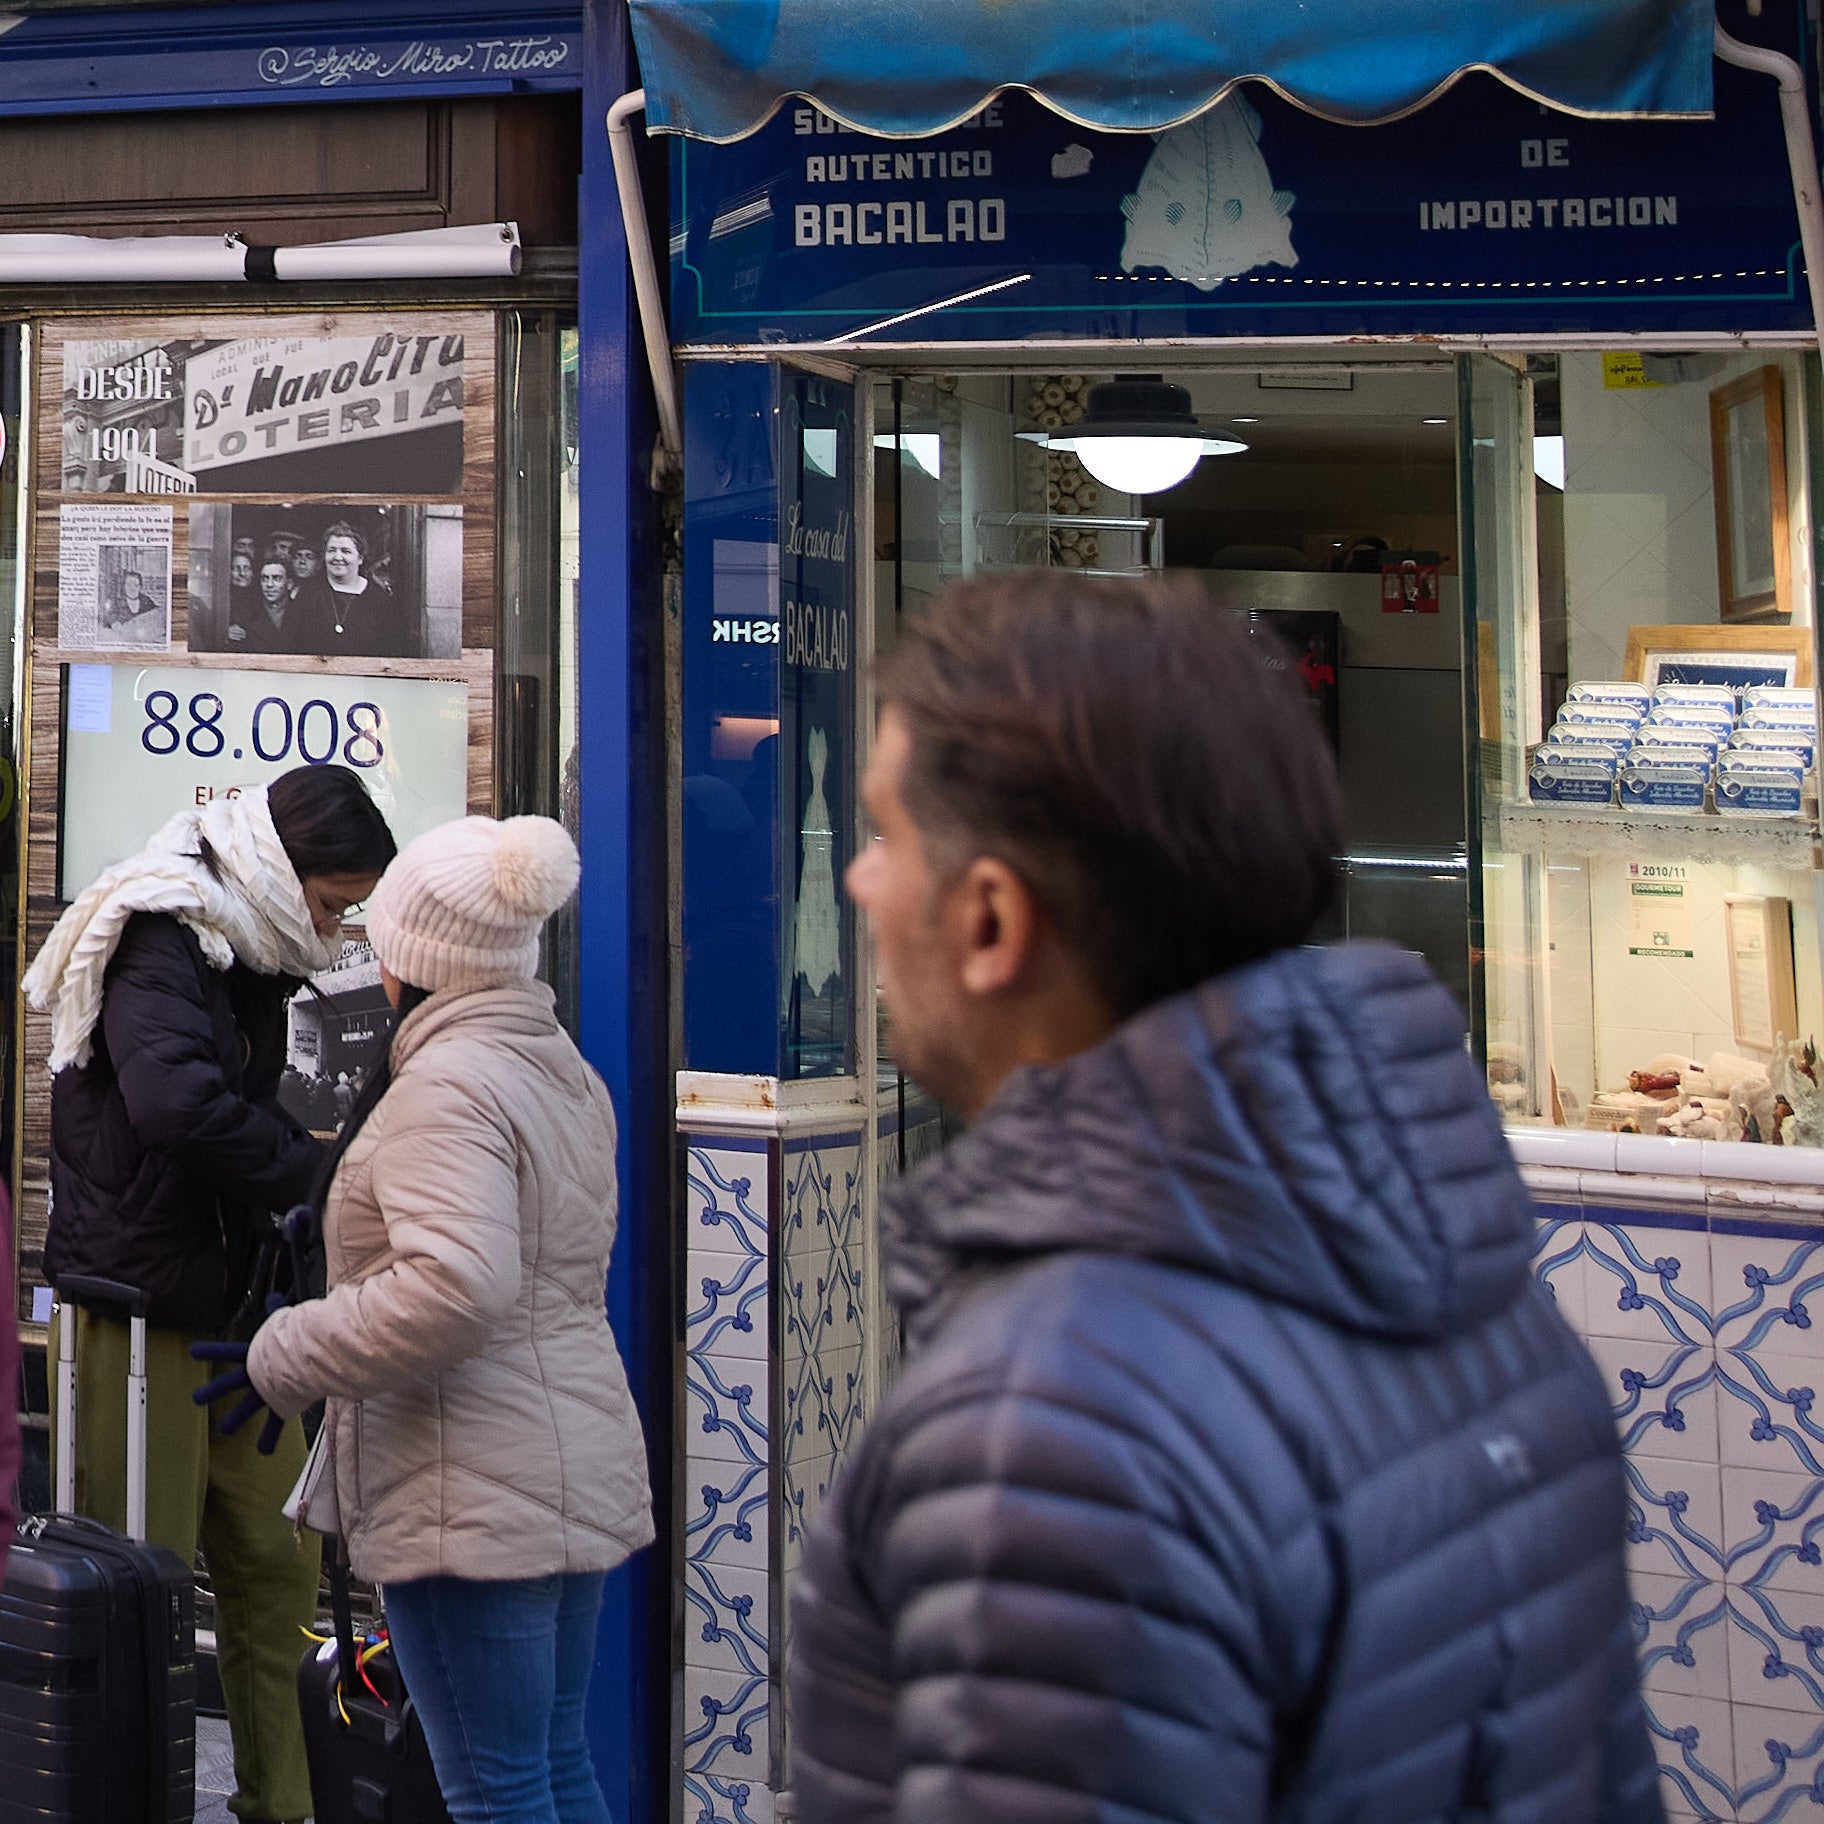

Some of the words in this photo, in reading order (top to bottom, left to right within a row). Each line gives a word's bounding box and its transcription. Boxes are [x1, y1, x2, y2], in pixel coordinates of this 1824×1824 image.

[806, 150, 992, 183] AUTENTICO
[1521, 138, 1569, 168] DE
[795, 198, 1005, 246] BACALAO
[1420, 196, 1677, 230] IMPORTACION
[77, 367, 171, 401] DESDE
[191, 376, 463, 464] LOTERIA
[785, 500, 802, 555] La
[805, 527, 829, 559] casa
[831, 510, 850, 563] del
[786, 600, 848, 670] BACALAO
[142, 690, 384, 768] 88.008
[1642, 866, 1686, 878] 2010/11
